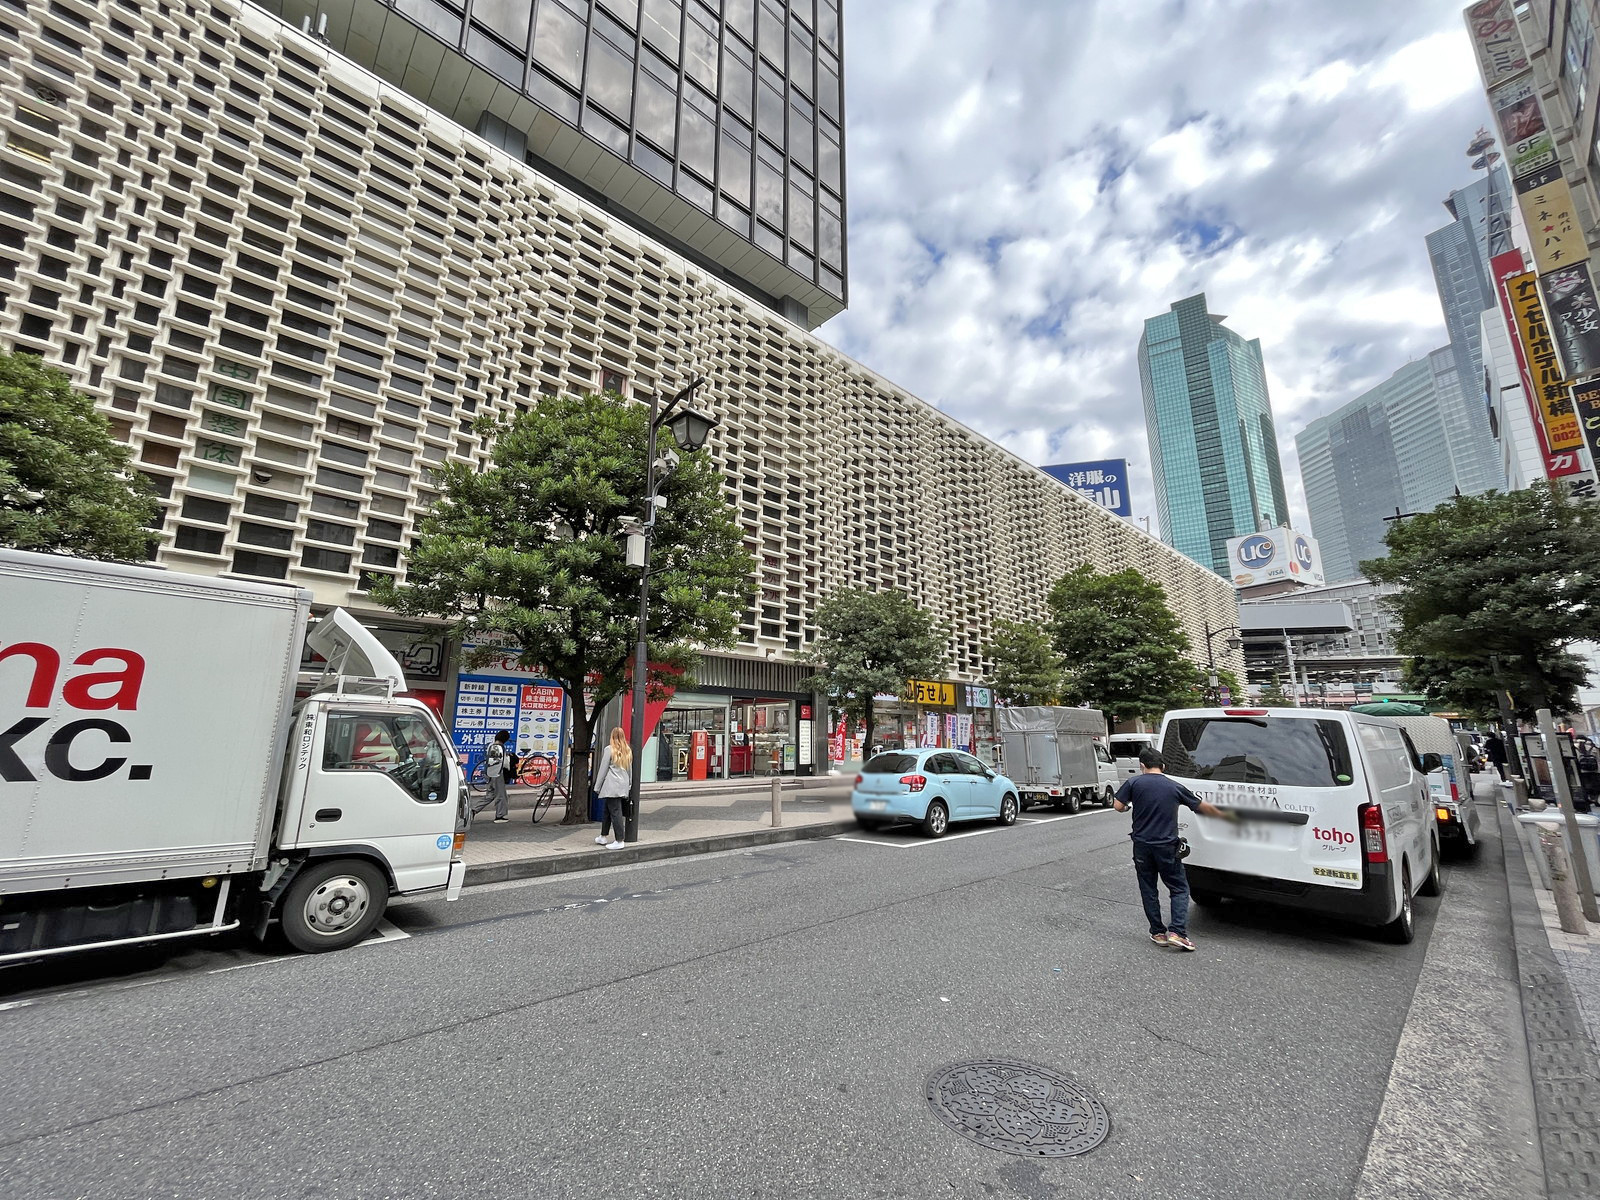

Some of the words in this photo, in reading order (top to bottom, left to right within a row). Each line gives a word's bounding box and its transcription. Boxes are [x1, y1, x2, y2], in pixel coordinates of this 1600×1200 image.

[1516, 136, 1540, 154] 6F
[203, 362, 251, 463] 中国整体
[1068, 469, 1117, 487] 洋服の
[1267, 568, 1285, 577] VISA
[464, 683, 485, 691] 新幹線
[494, 685, 514, 693] 商品券
[530, 687, 555, 696] CABIN
[526, 695, 559, 703] 株主優待券
[492, 708, 511, 716] 航空券
[457, 719, 483, 727] ビール券
[1312, 826, 1355, 845] toho
[1322, 844, 1347, 853] グループ
[1313, 867, 1359, 881] 安全運転宣言車
